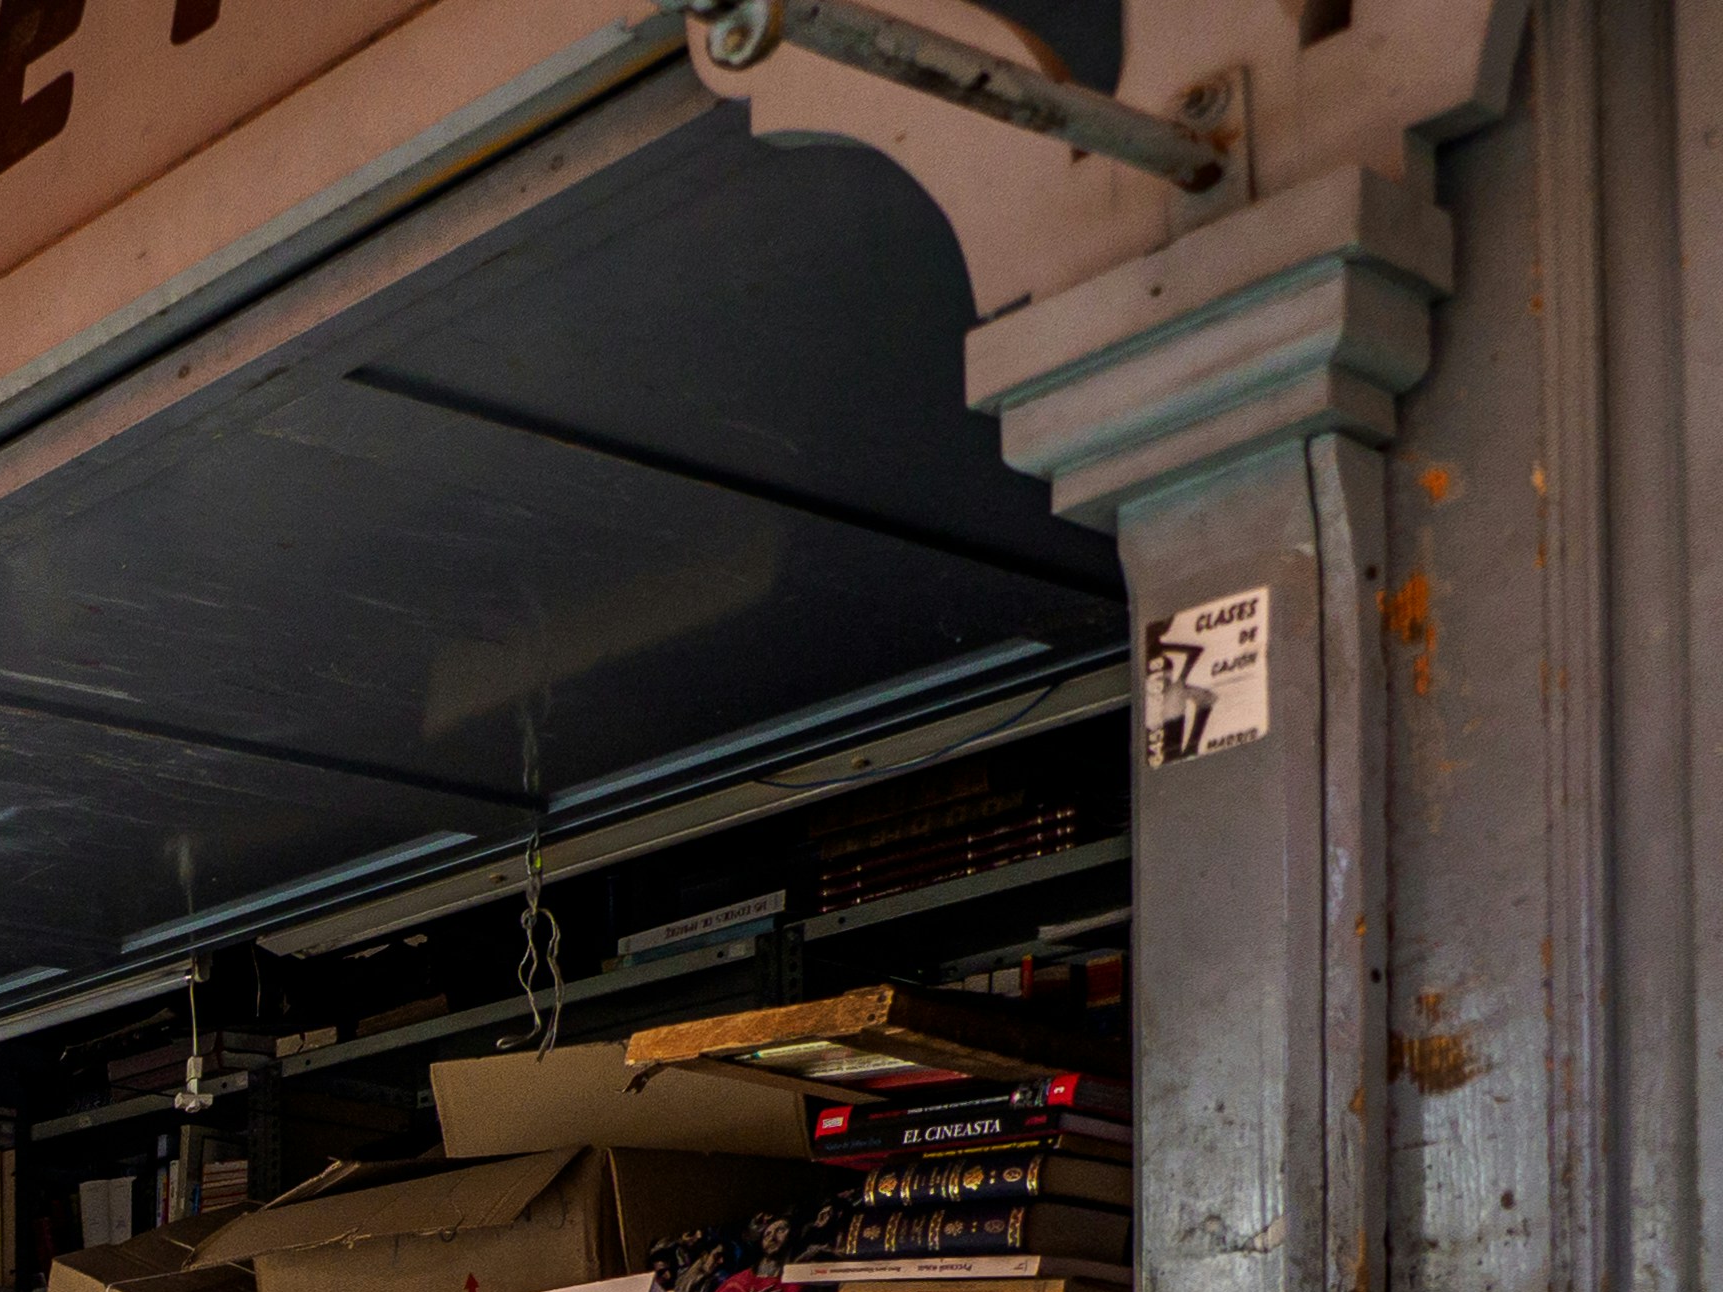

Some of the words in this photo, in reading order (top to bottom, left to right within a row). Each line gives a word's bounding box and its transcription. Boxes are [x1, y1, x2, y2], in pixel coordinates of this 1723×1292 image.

[1195, 597, 1258, 634] CLASES
[1238, 627, 1257, 645] DE
[902, 1128, 923, 1145] EL
[925, 1119, 1002, 1142] CINEASTA
